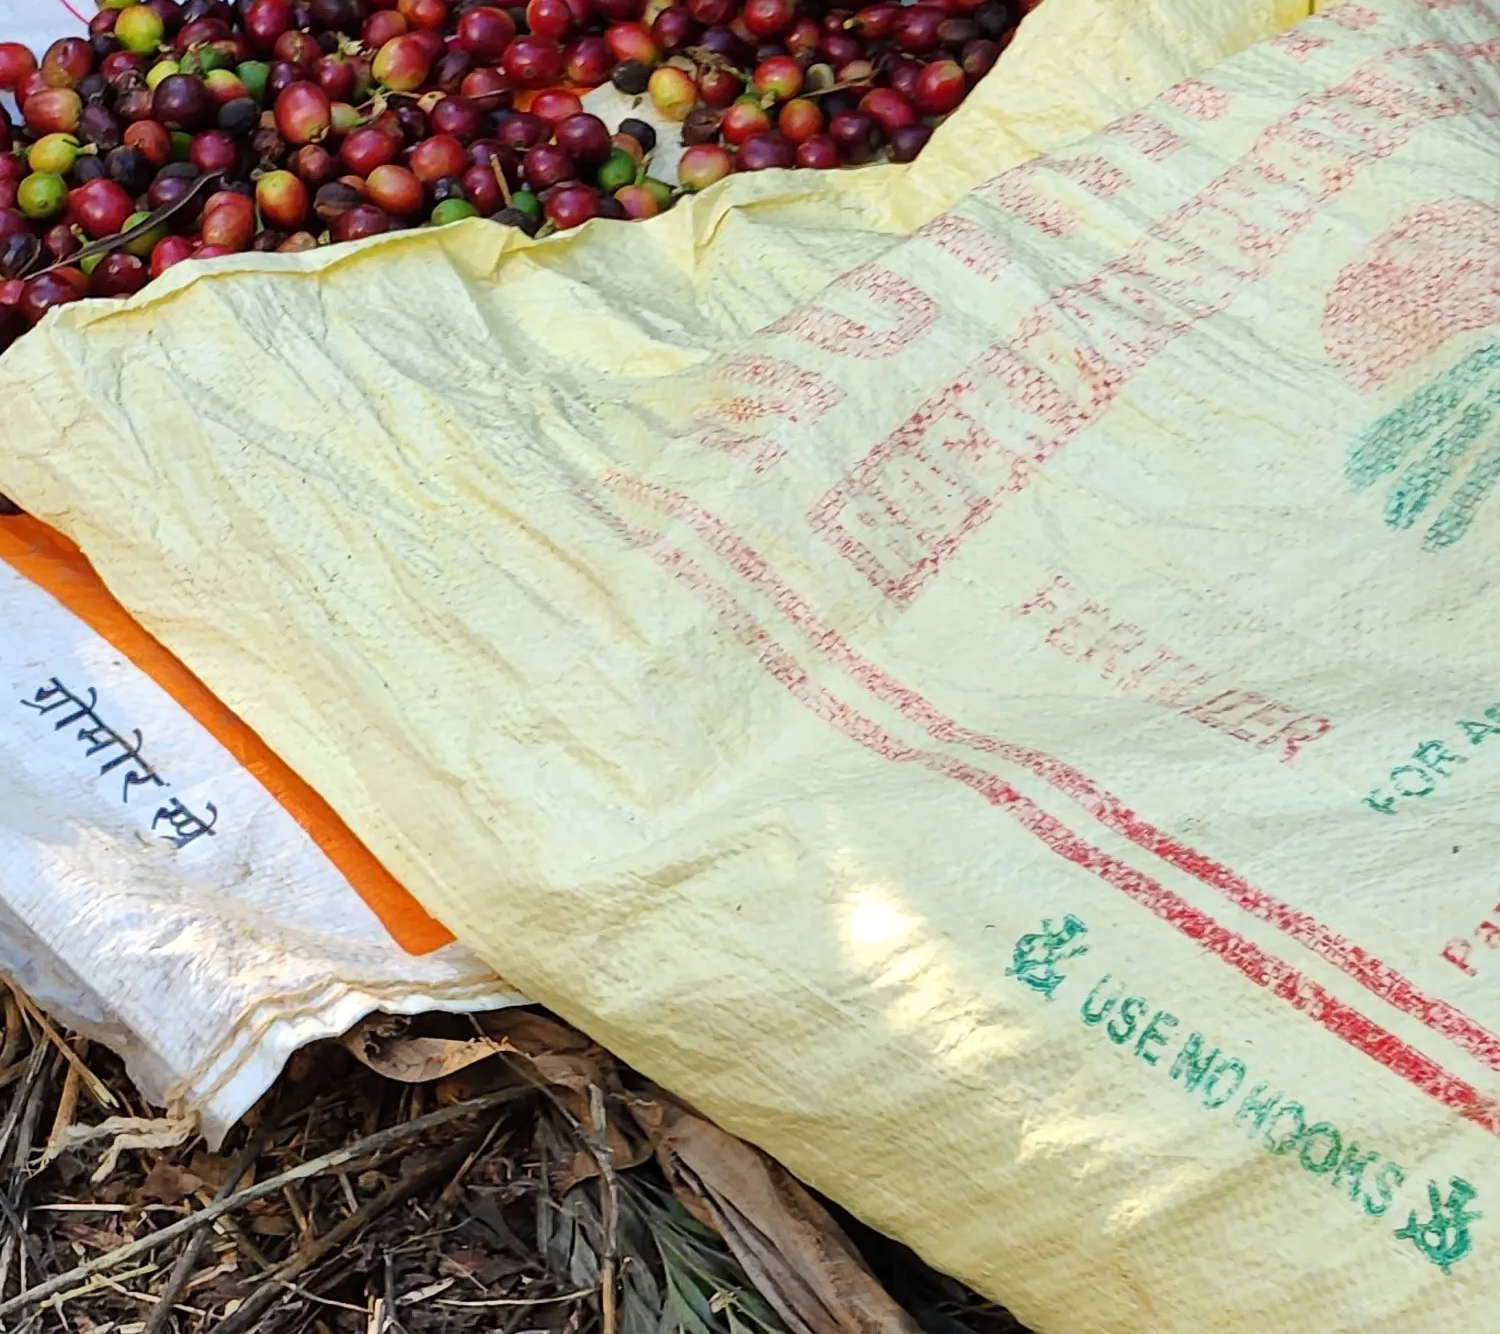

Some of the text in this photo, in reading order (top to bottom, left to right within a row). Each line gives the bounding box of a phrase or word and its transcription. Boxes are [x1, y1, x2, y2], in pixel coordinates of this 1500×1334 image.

[1017, 575, 1332, 763] FERTILIZER
[1361, 739, 1468, 815] FOR
[1080, 973, 1407, 1216] USE NO HOOKS
